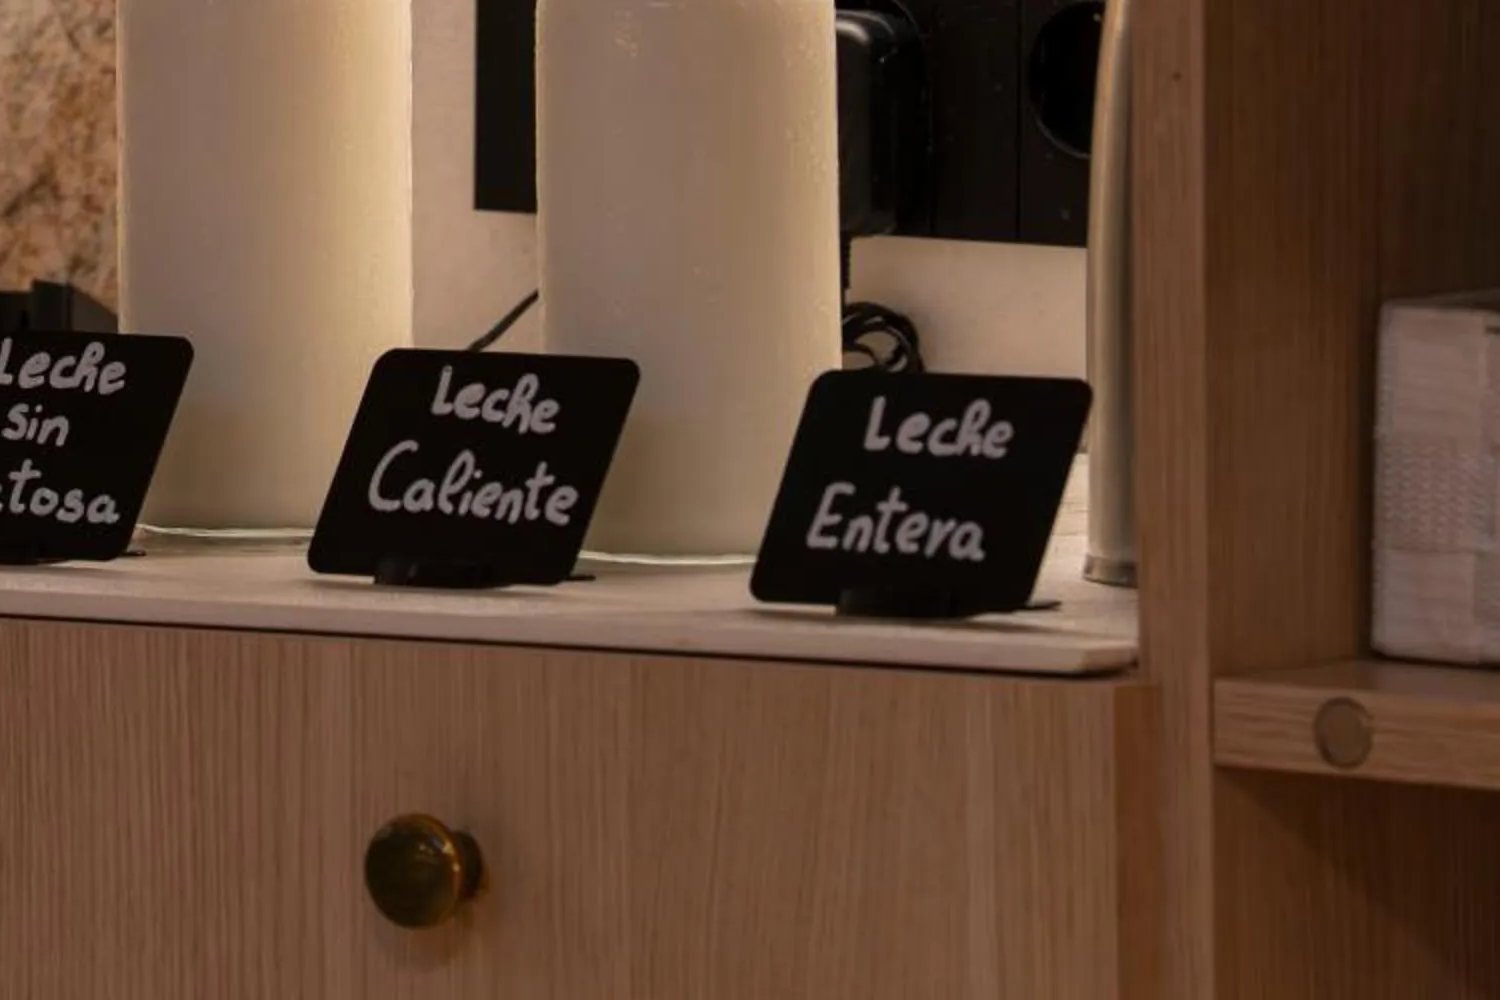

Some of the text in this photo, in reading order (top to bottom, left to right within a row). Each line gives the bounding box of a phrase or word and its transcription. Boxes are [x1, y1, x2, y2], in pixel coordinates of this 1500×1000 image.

[2, 404, 68, 446] sin
[432, 366, 559, 433] Leche
[864, 397, 1012, 457] Leche
[369, 440, 577, 525] Caliente
[807, 483, 984, 560] Entera
